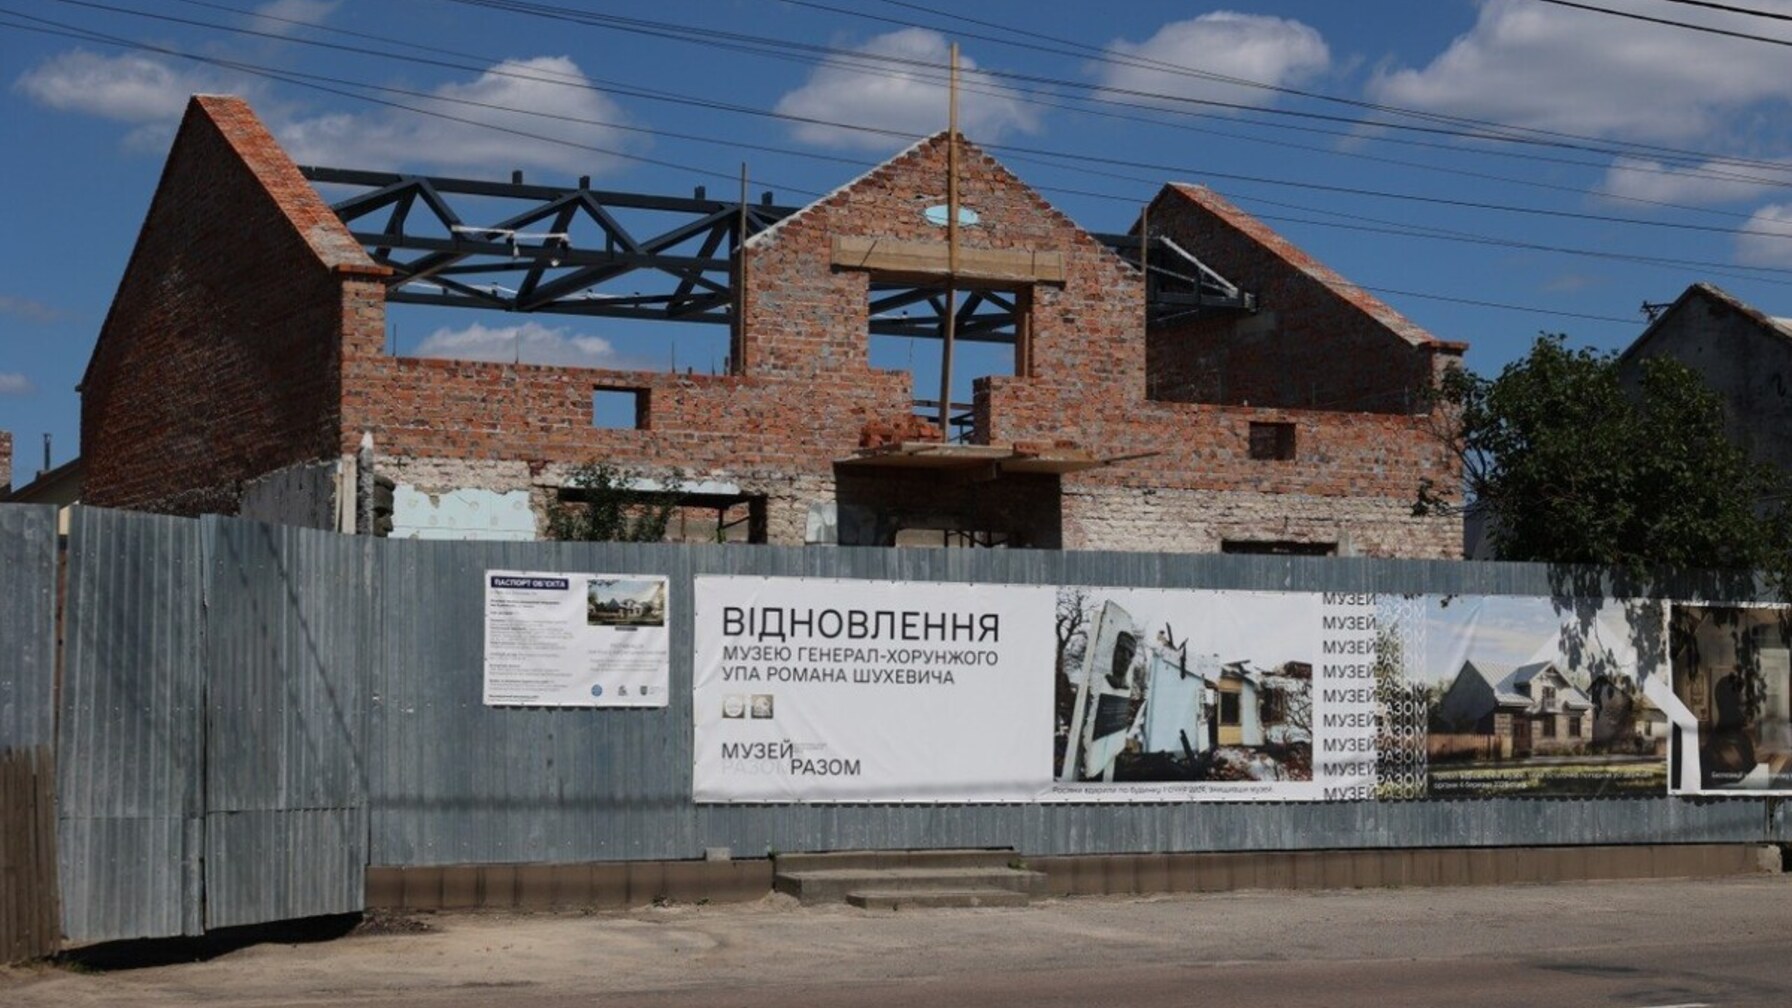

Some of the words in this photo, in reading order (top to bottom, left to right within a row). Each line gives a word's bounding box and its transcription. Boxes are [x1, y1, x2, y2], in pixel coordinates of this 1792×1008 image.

[494, 578, 531, 587] ПАСПОРТ
[723, 607, 999, 643] ВІДНОВЛЕННЯ
[1322, 614, 1376, 630] МУЗЕЙ
[1322, 638, 1376, 654] МУЗЕЙ
[723, 646, 792, 662] МУЗЕЮ
[797, 647, 999, 666] ГЕНЕРАЛ-ХОРУНЖОГО
[722, 666, 761, 682] УПА
[766, 667, 848, 683] РОМАНА
[853, 669, 955, 685] ШУХЕВИЧА
[1323, 662, 1376, 678] МУЗЕЙ
[1323, 687, 1376, 703] МУЗЕЙ
[1323, 711, 1376, 727] МУЗЕЙ
[722, 739, 793, 759] МУЗЕЙ
[1323, 736, 1376, 752] МУЗЕЙ
[790, 759, 861, 776] РАЗОМ
[1323, 760, 1377, 776] МУЗЕЙ
[1323, 784, 1377, 800] МУЗЕЙ
